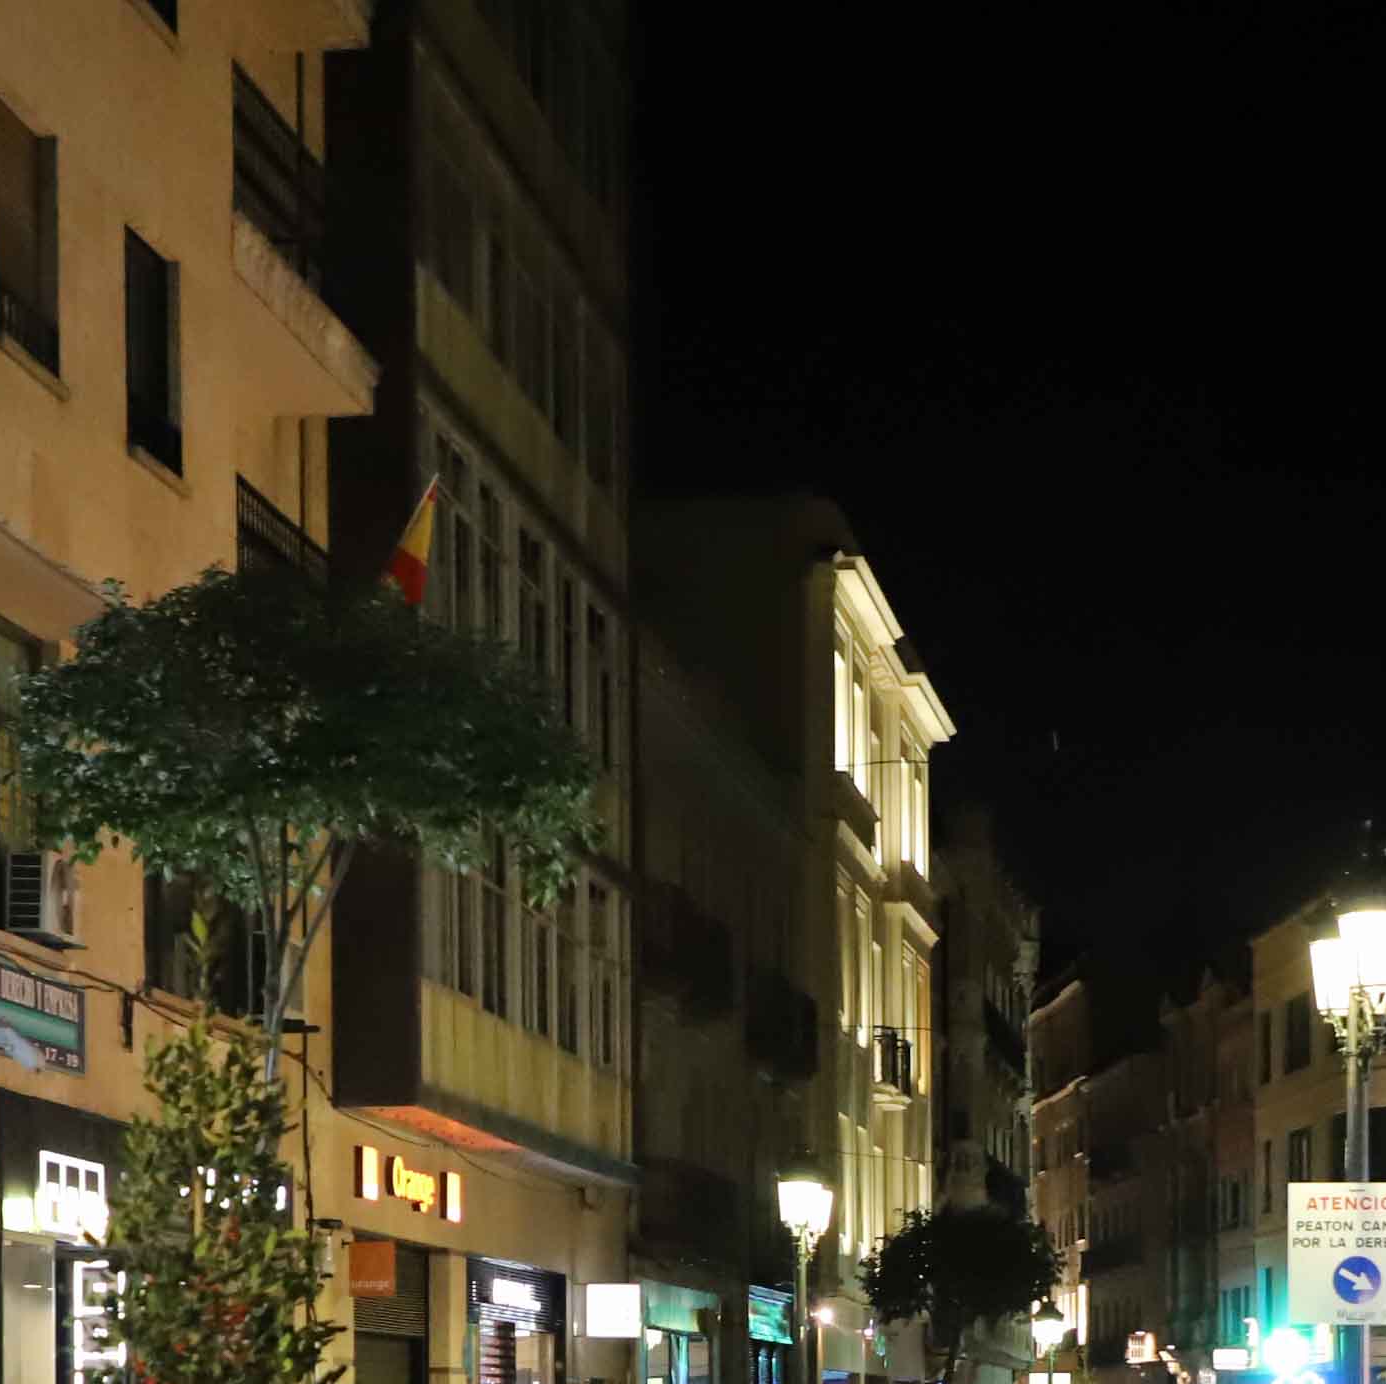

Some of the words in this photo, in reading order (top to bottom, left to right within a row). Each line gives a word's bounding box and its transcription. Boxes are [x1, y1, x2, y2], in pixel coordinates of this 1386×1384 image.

[388, 1155, 435, 1213] Orange
[1296, 1220, 1353, 1232] PEATON
[1292, 1237, 1320, 1249] POR
[1329, 1237, 1346, 1249] LA
